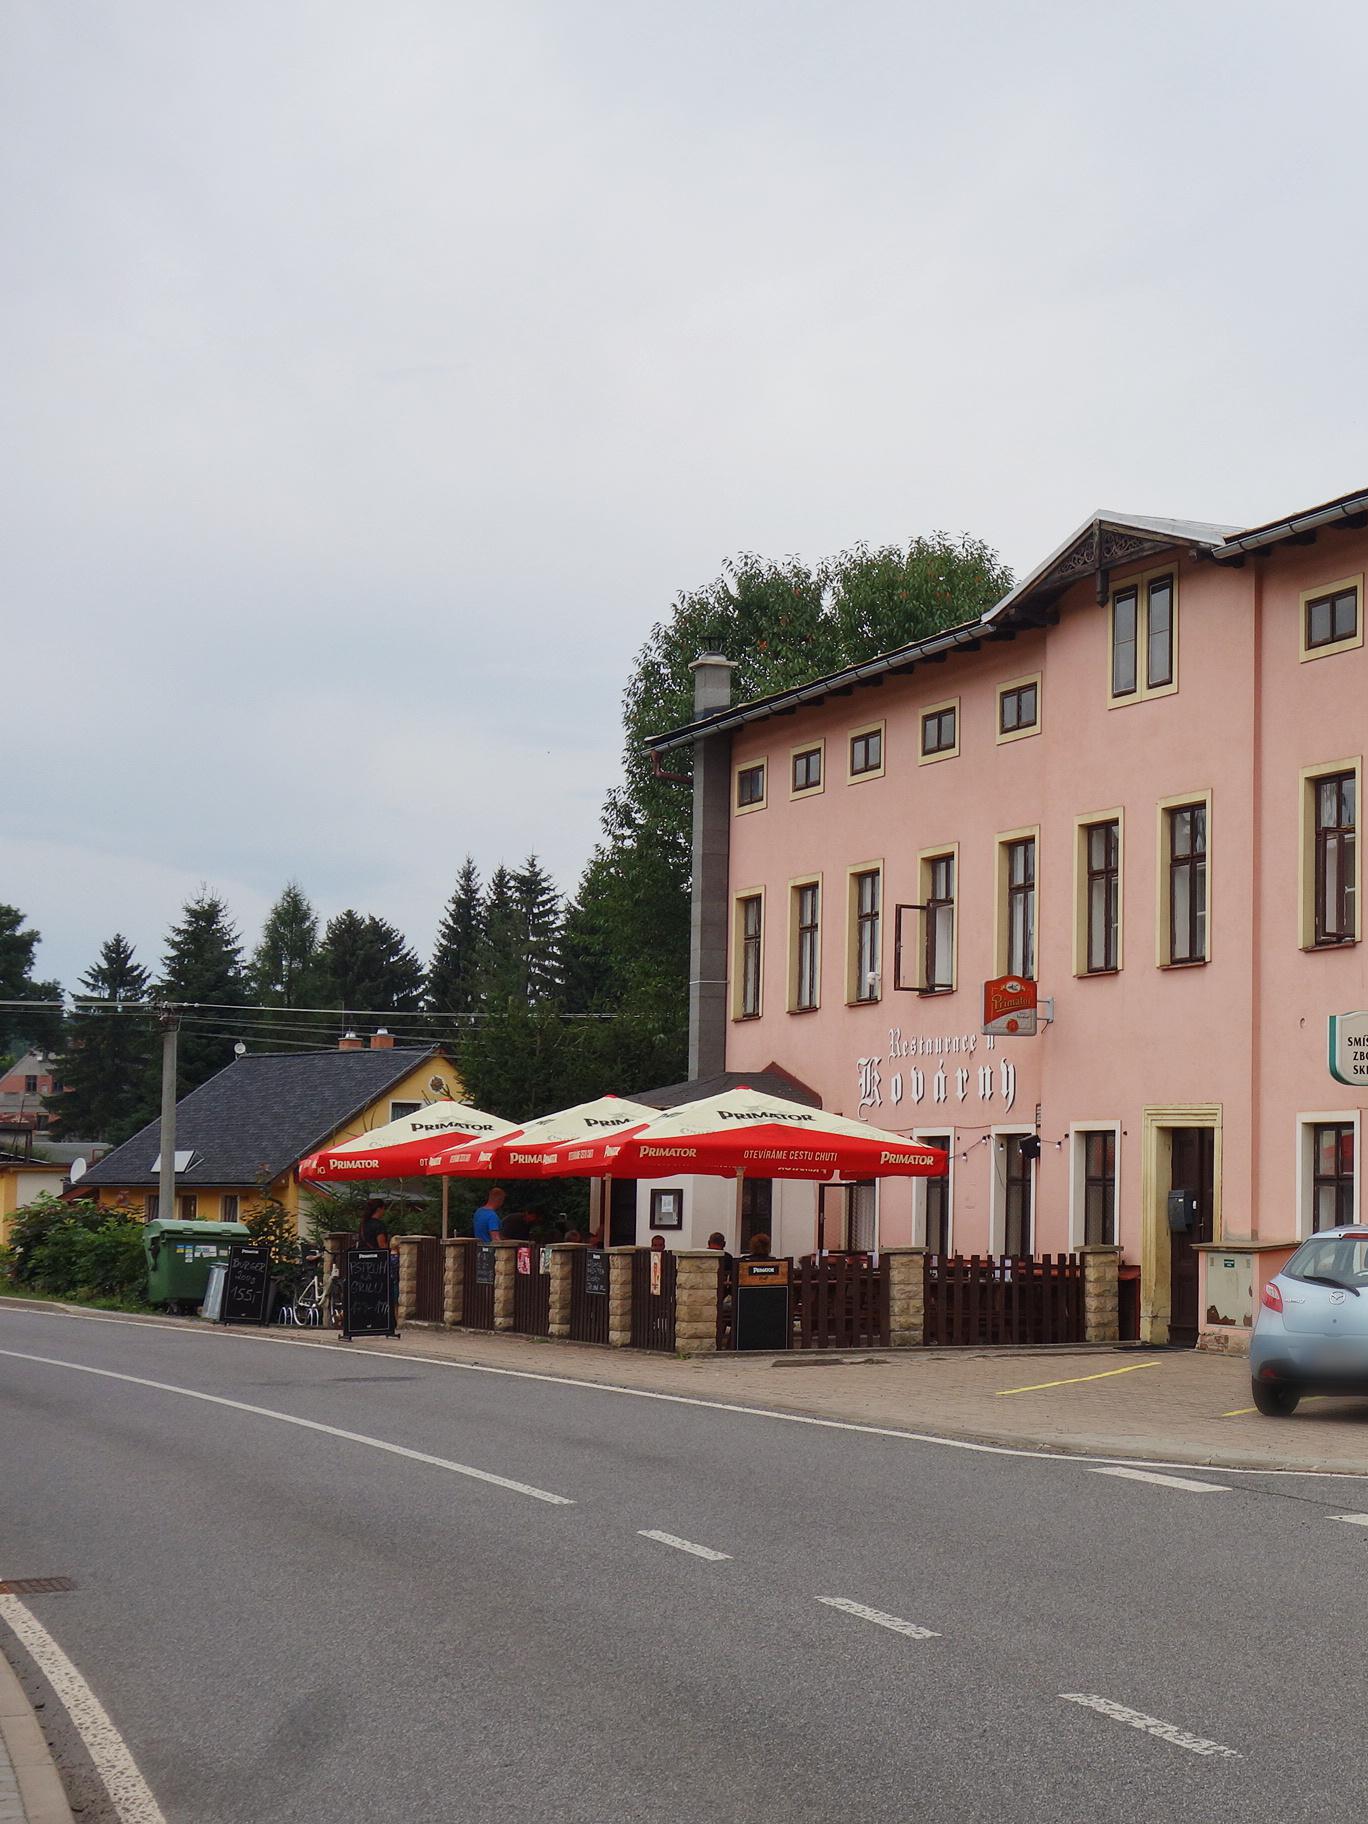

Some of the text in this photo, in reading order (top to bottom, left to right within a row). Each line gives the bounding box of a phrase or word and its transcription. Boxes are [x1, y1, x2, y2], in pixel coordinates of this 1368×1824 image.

[888, 1026, 977, 1064] Restaurace
[856, 1056, 1017, 1121] Kovárny
[717, 1110, 816, 1121] PRIMATOR
[411, 1121, 494, 1132] PRIMATOR
[639, 1145, 697, 1158] PRIMATOR
[743, 1148, 787, 1160] OTEVÍRÁME
[789, 1150, 813, 1161] CESTU
[880, 1151, 934, 1165] PRIMATOR
[329, 1159, 379, 1169] PRIMATOR
